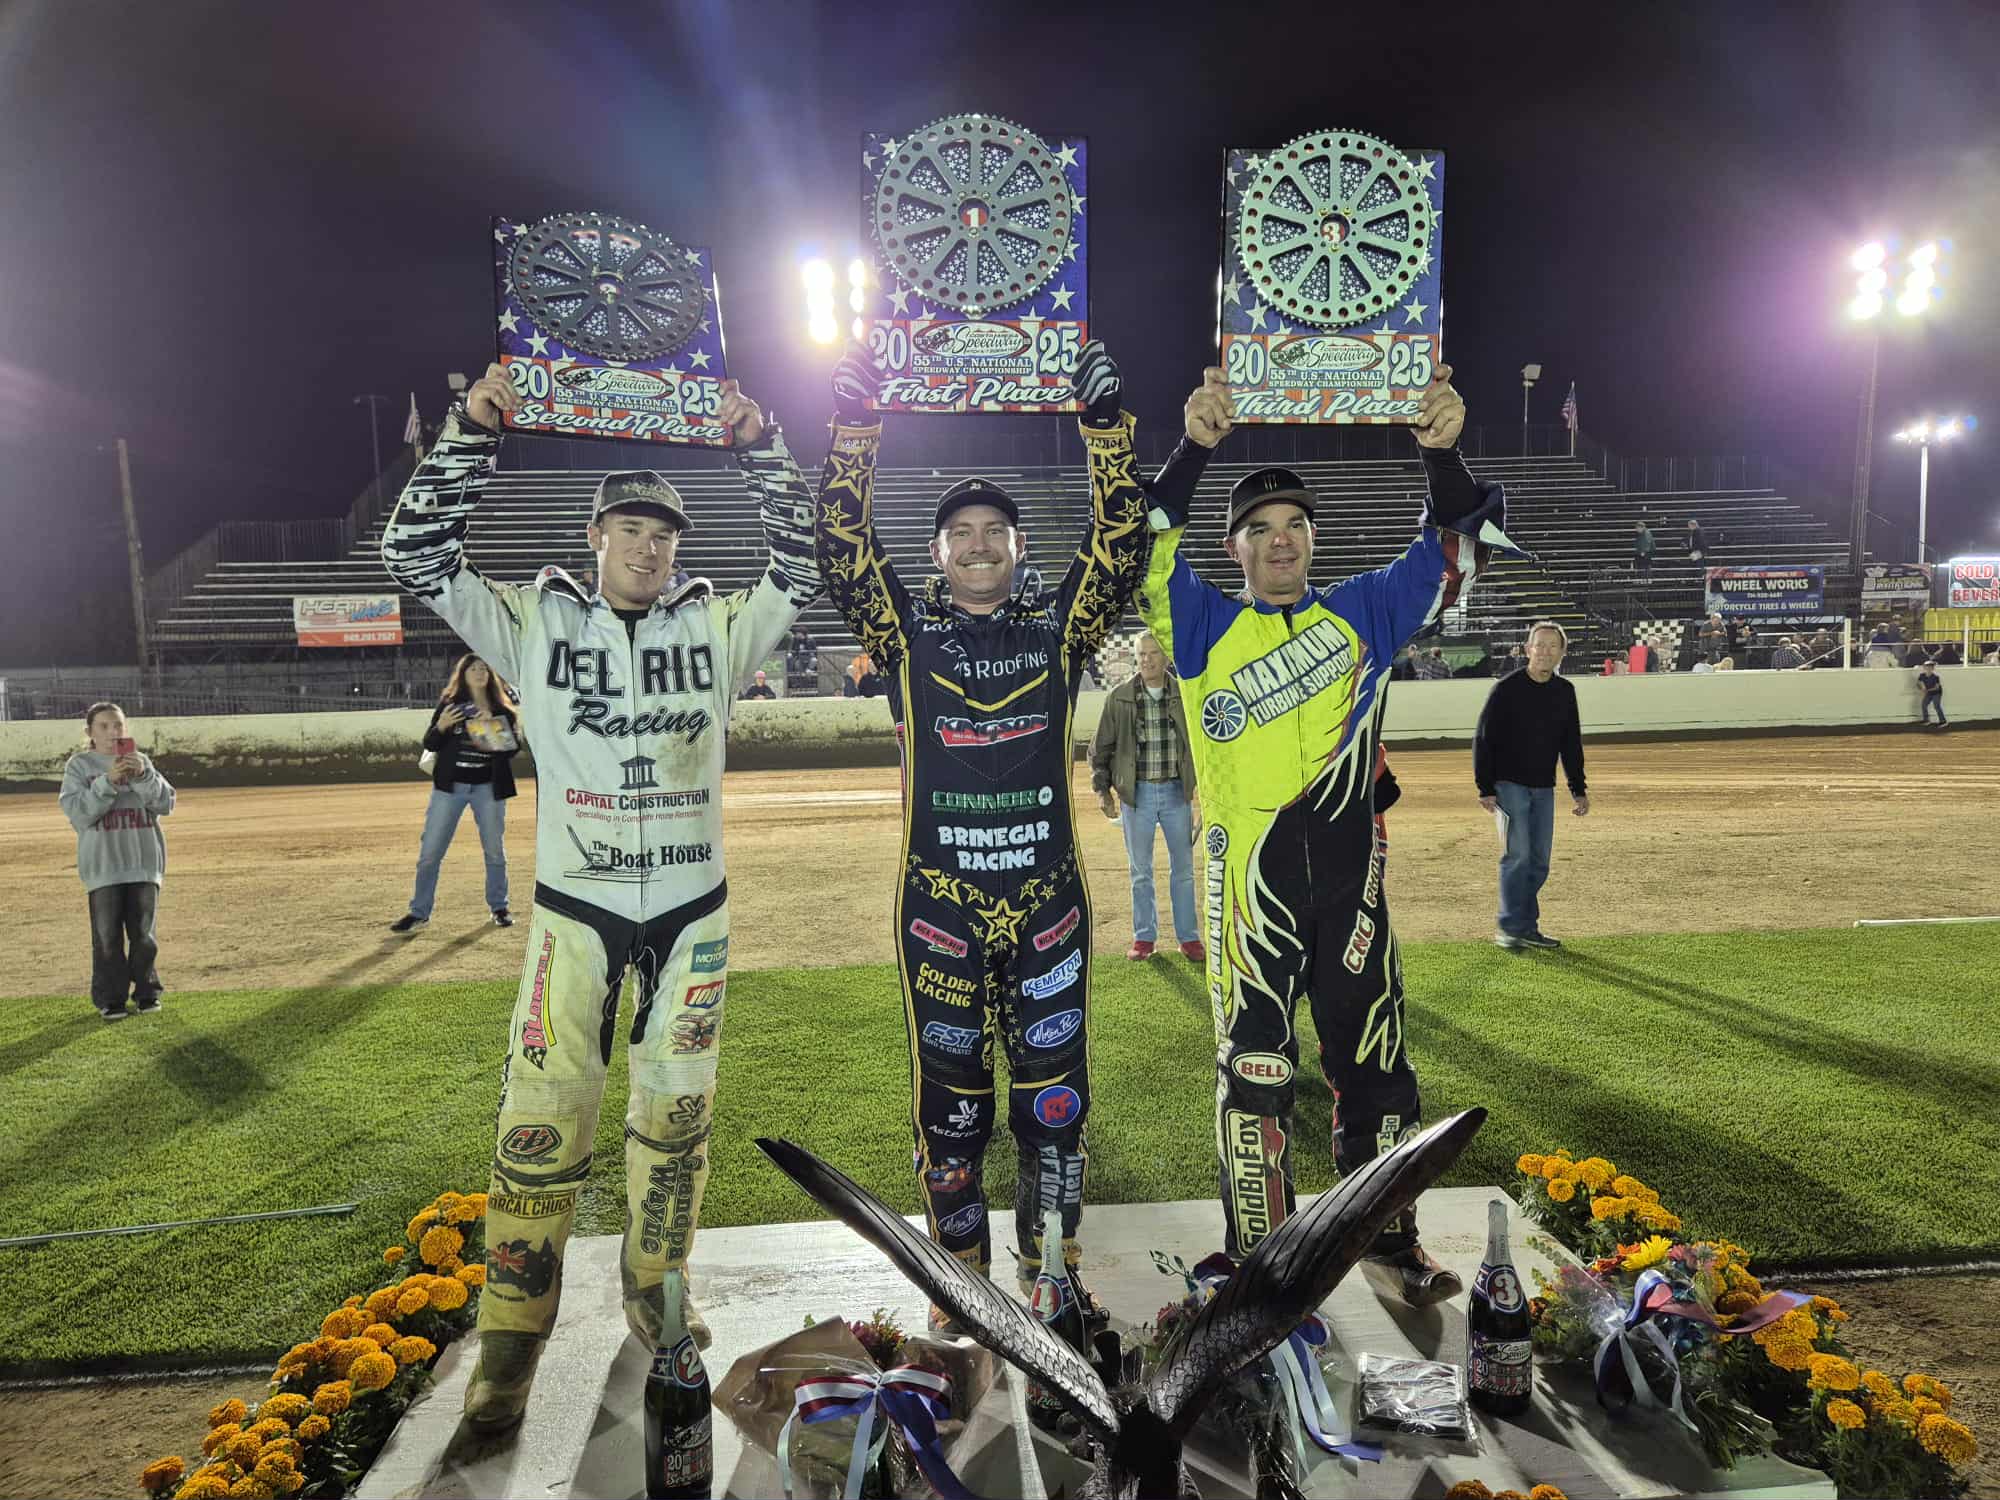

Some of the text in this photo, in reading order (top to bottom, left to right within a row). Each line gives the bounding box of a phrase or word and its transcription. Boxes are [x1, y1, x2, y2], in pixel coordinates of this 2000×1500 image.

[966, 207, 979, 229] 1
[1323, 222, 1341, 246] 3
[869, 327, 907, 371] 20
[952, 326, 1021, 354] Speedway
[1039, 327, 1081, 374] 25
[1307, 340, 1374, 367] Speedway
[913, 366, 1032, 374] SPEEDWAY CHAMPIONSHIP
[946, 357, 966, 367] U.S.
[971, 357, 1032, 367] NATIONAL
[1228, 342, 1265, 386] 20
[1301, 370, 1320, 381] U.S.
[1325, 370, 1383, 381] NATIONAL
[1391, 341, 1431, 386] 25
[507, 362, 549, 399] 20
[880, 377, 1072, 407] First Place
[1269, 380, 1383, 388] SPEEDWAY CHAMPIONSHIP
[615, 395, 675, 408] NATIONAL
[682, 380, 721, 416] 25
[1233, 391, 1420, 418] Third Place
[513, 403, 727, 438] Second Place
[1721, 579, 1808, 591] WHEEL WORKS
[1955, 564, 1994, 579] COLD
[1709, 602, 1757, 611] MOTORCYCLE
[1789, 601, 1819, 609] WHEELS
[547, 639, 713, 699] DEL RIO
[976, 648, 1049, 679] ROOFING
[1231, 618, 1350, 707] MAXIMUM
[567, 695, 712, 746] Racing
[1249, 682, 1309, 728] TURBINE
[566, 788, 710, 811] CAPITAL CONSTRUCTION
[592, 840, 609, 852] The
[938, 820, 1050, 848] BRINEGAR
[610, 844, 713, 869] Boat House
[957, 847, 1036, 872] RACING
[1207, 858, 1226, 976] MAXIMUM
[1343, 910, 1376, 974] CNC
[919, 961, 976, 993] GOLDEN
[1024, 951, 1081, 994] KEMPTON
[915, 976, 972, 1008] RACING
[1240, 1061, 1285, 1078] BELL
[640, 1158, 681, 1255] Wayne
[662, 1154, 706, 1263] Grandpa
[1035, 1283, 1054, 1317] 1
[1494, 1273, 1521, 1306] 3
[681, 1345, 701, 1380] 2
[667, 1454, 683, 1471] 20
